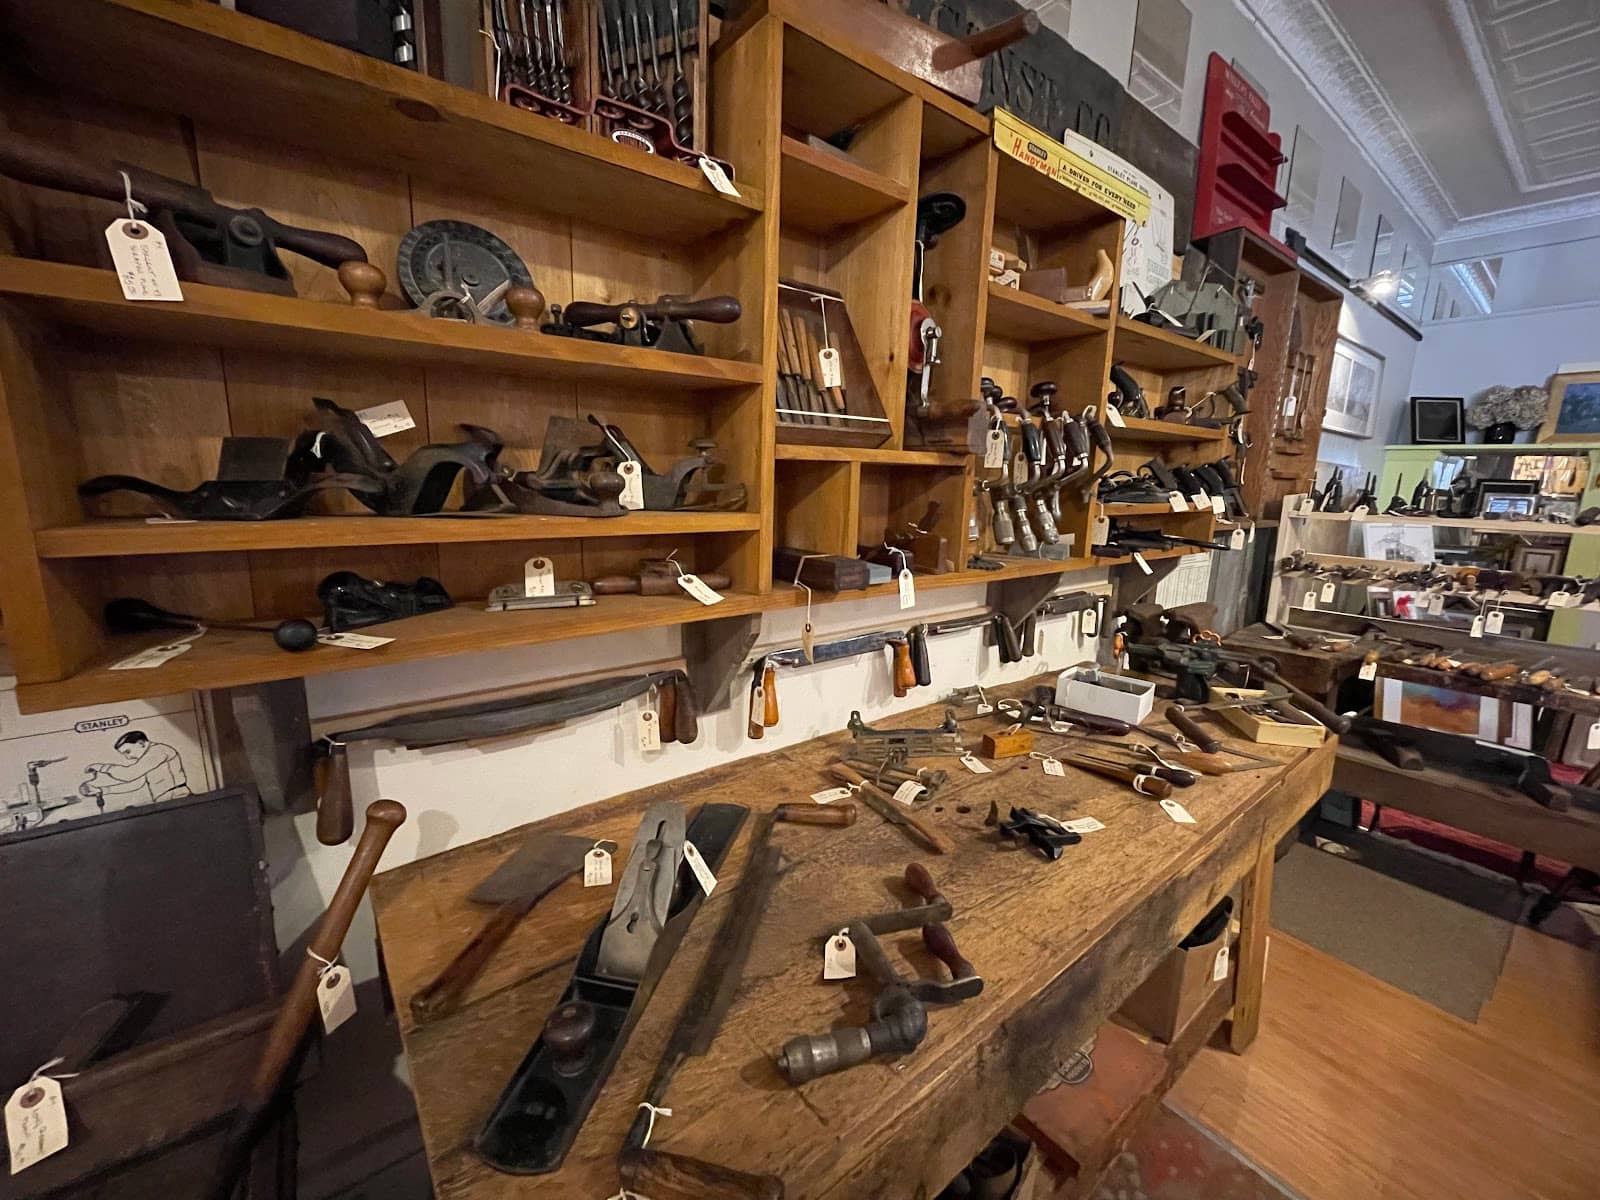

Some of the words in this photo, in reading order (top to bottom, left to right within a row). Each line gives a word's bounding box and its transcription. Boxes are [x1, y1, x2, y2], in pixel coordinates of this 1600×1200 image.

[1012, 137, 1057, 176] HANDYMAN
[1069, 168, 1090, 183] DRIVER
[1091, 180, 1102, 191] FOR
[1104, 188, 1122, 203] EVERY
[1123, 197, 1136, 210] NEED
[80, 718, 123, 730] STANLEY
